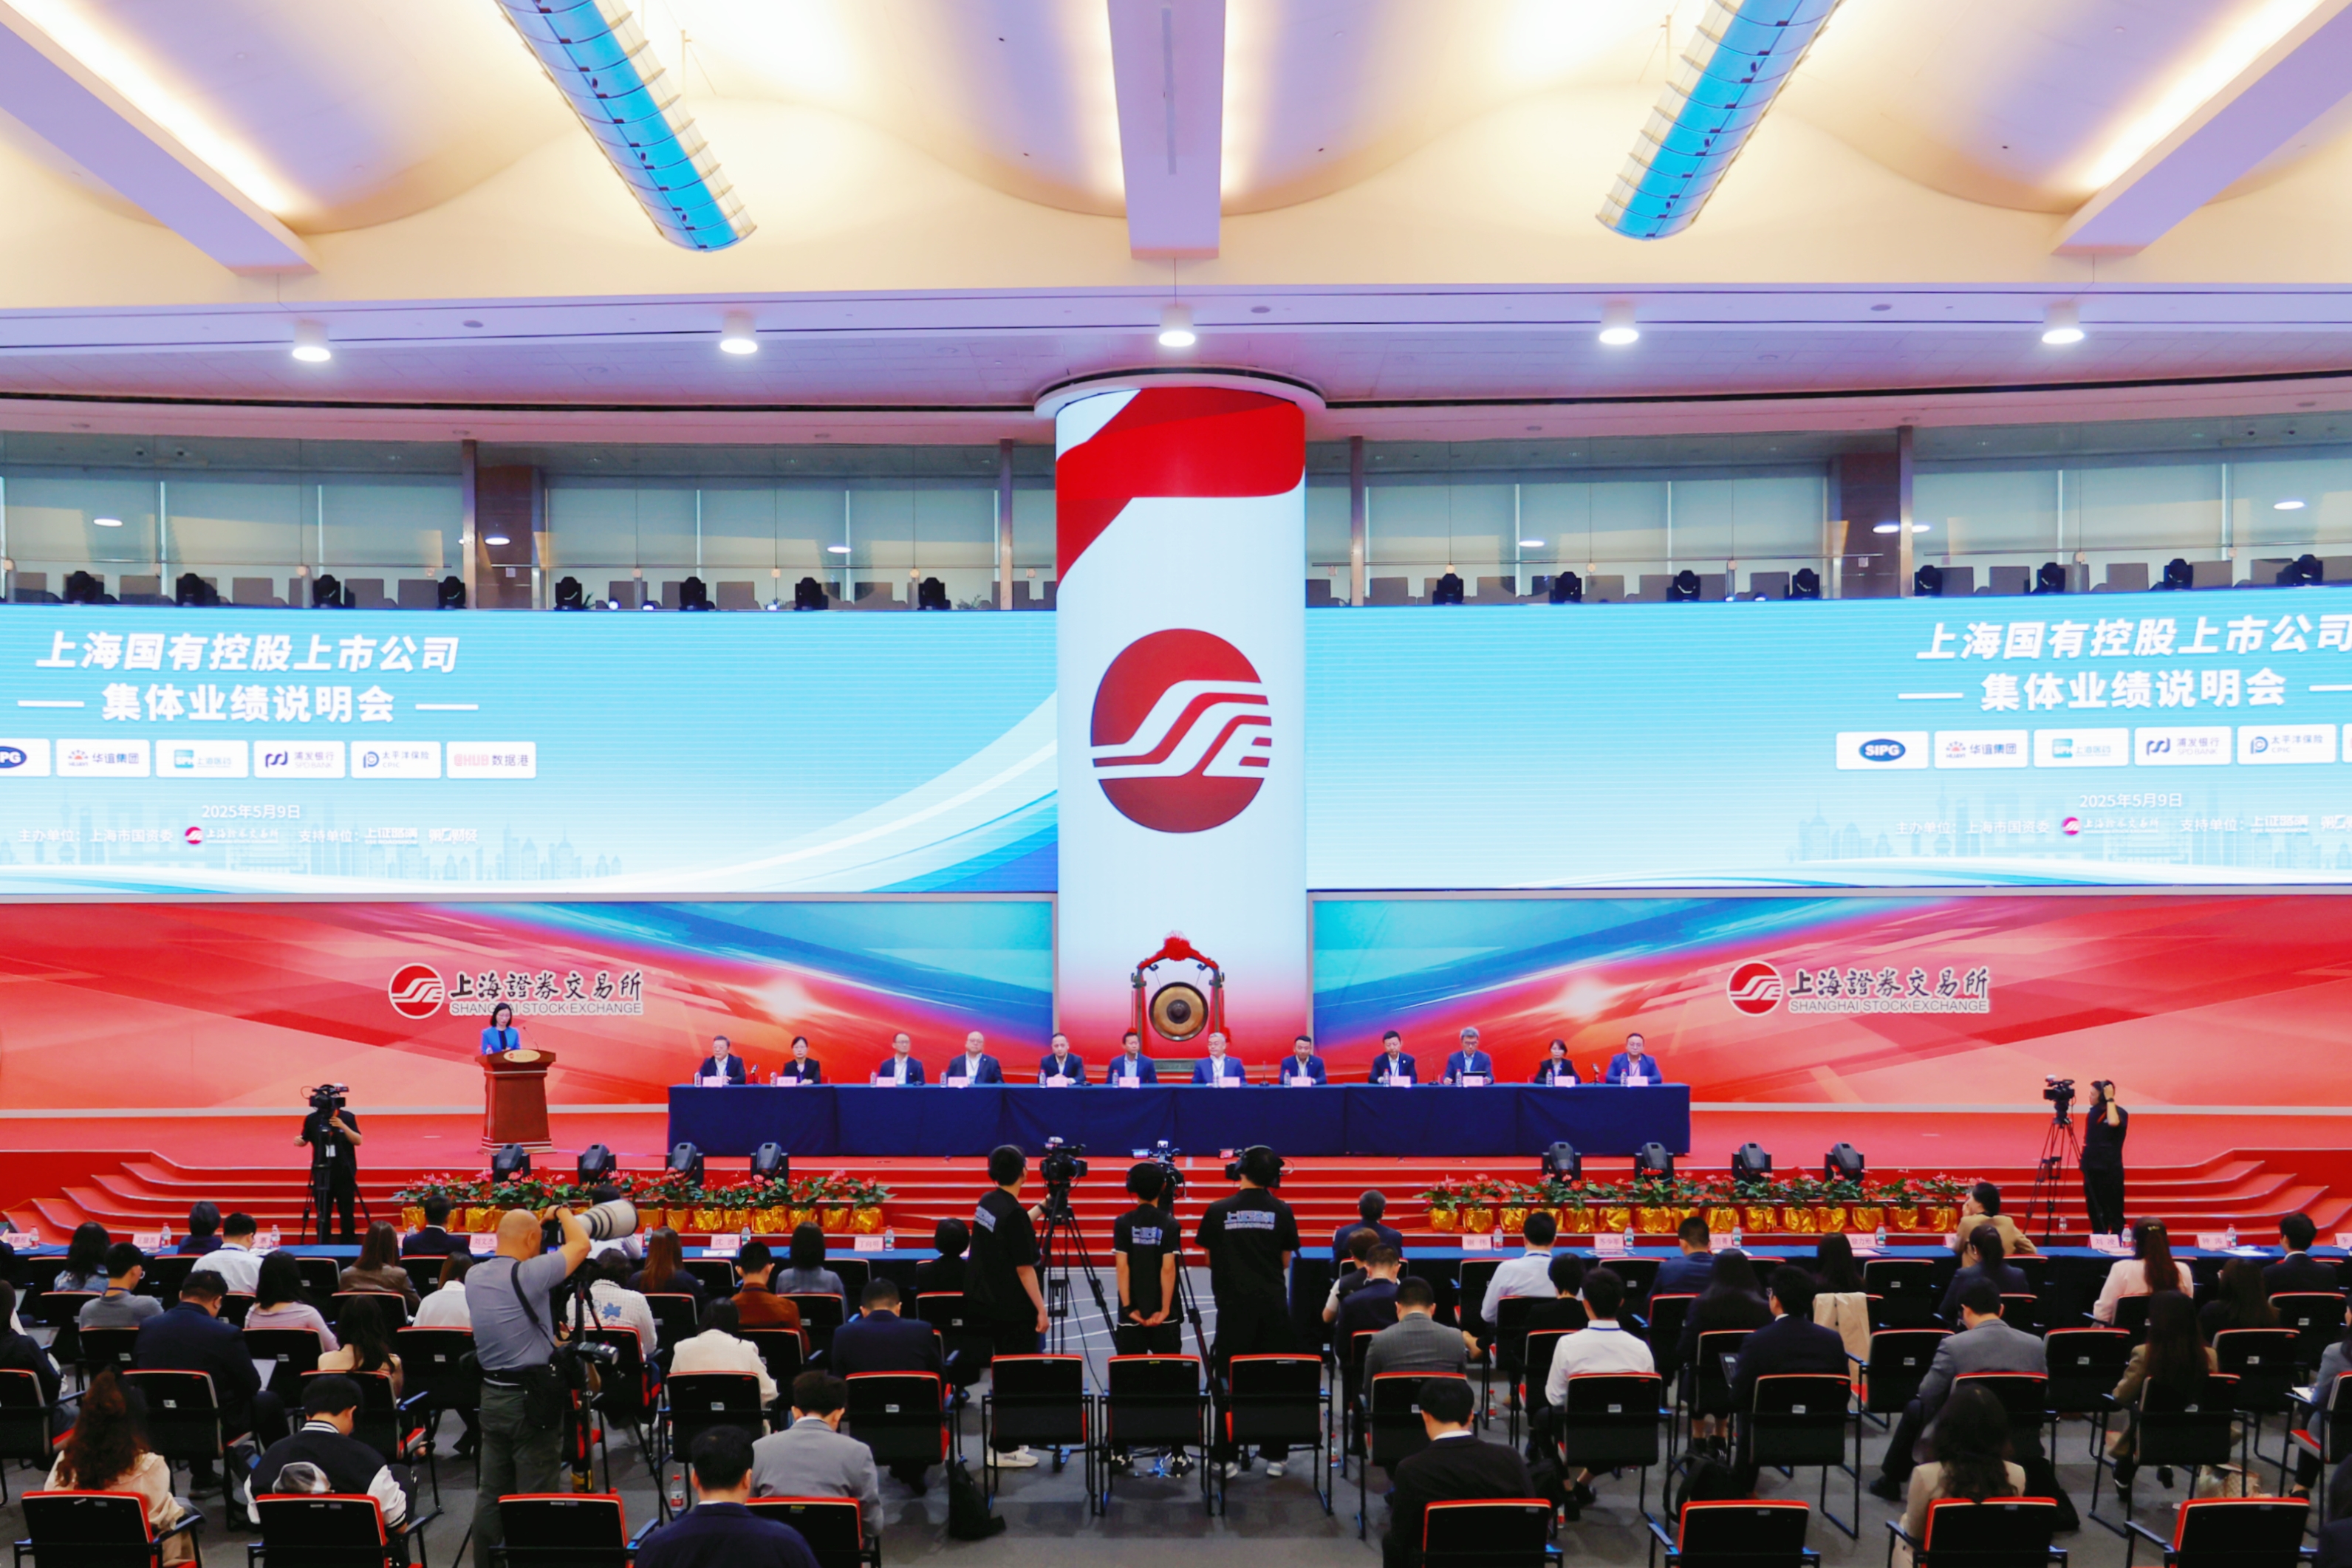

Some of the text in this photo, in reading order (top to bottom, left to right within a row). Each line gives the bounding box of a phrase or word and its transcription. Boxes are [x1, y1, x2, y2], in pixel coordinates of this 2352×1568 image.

[1916, 614, 2352, 660] 上海国有控股上市公司
[35, 631, 460, 673] 上海国有控股上市公司
[1981, 667, 2287, 711] 集体业绩说明会
[102, 682, 394, 723] 集体业绩说明会
[2176, 737, 2220, 747] 浦发银行
[2271, 735, 2323, 744] 太平洋保险
[382, 750, 429, 760] 太平洋保险
[1864, 744, 1901, 757] SIPG
[1969, 743, 2017, 755] 华谊集团
[92, 753, 140, 764] 华谊集团
[294, 751, 334, 761] 浦发银行
[491, 754, 529, 766] 数据港
[2079, 792, 2182, 808] 2025年5月9日
[201, 804, 300, 819] 2025年5月9日
[1965, 821, 2050, 835] 上海市国资委
[89, 829, 174, 843] 上海市国资委
[451, 1002, 641, 1013] SHANGAI STOCK EXCHANGE
[1790, 1001, 1988, 1012] SHANGHAI STOCK EXCHANGE
[474, 1237, 494, 1245] 刘文杰
